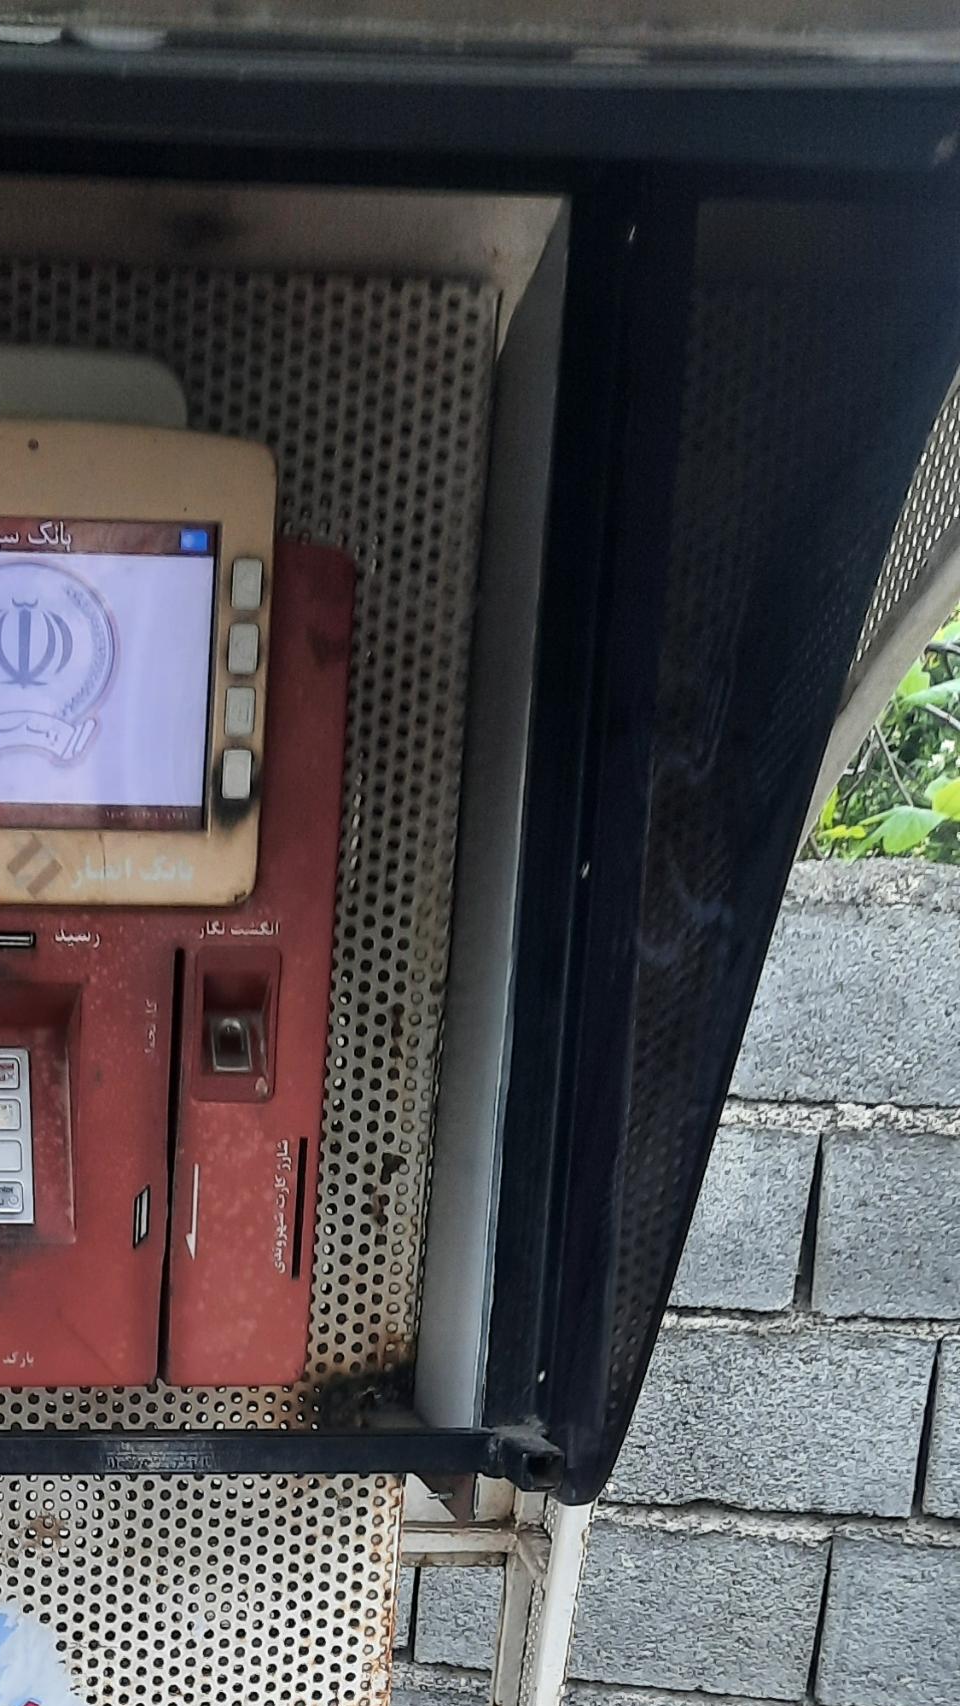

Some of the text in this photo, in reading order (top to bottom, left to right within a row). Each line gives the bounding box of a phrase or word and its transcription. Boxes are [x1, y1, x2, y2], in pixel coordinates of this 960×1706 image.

[27, 521, 73, 552] بانک
[54, 928, 100, 947] رسید
[199, 920, 280, 939] انگشت نگار
[272, 1139, 292, 1273] شارژ کارت شهروندی
